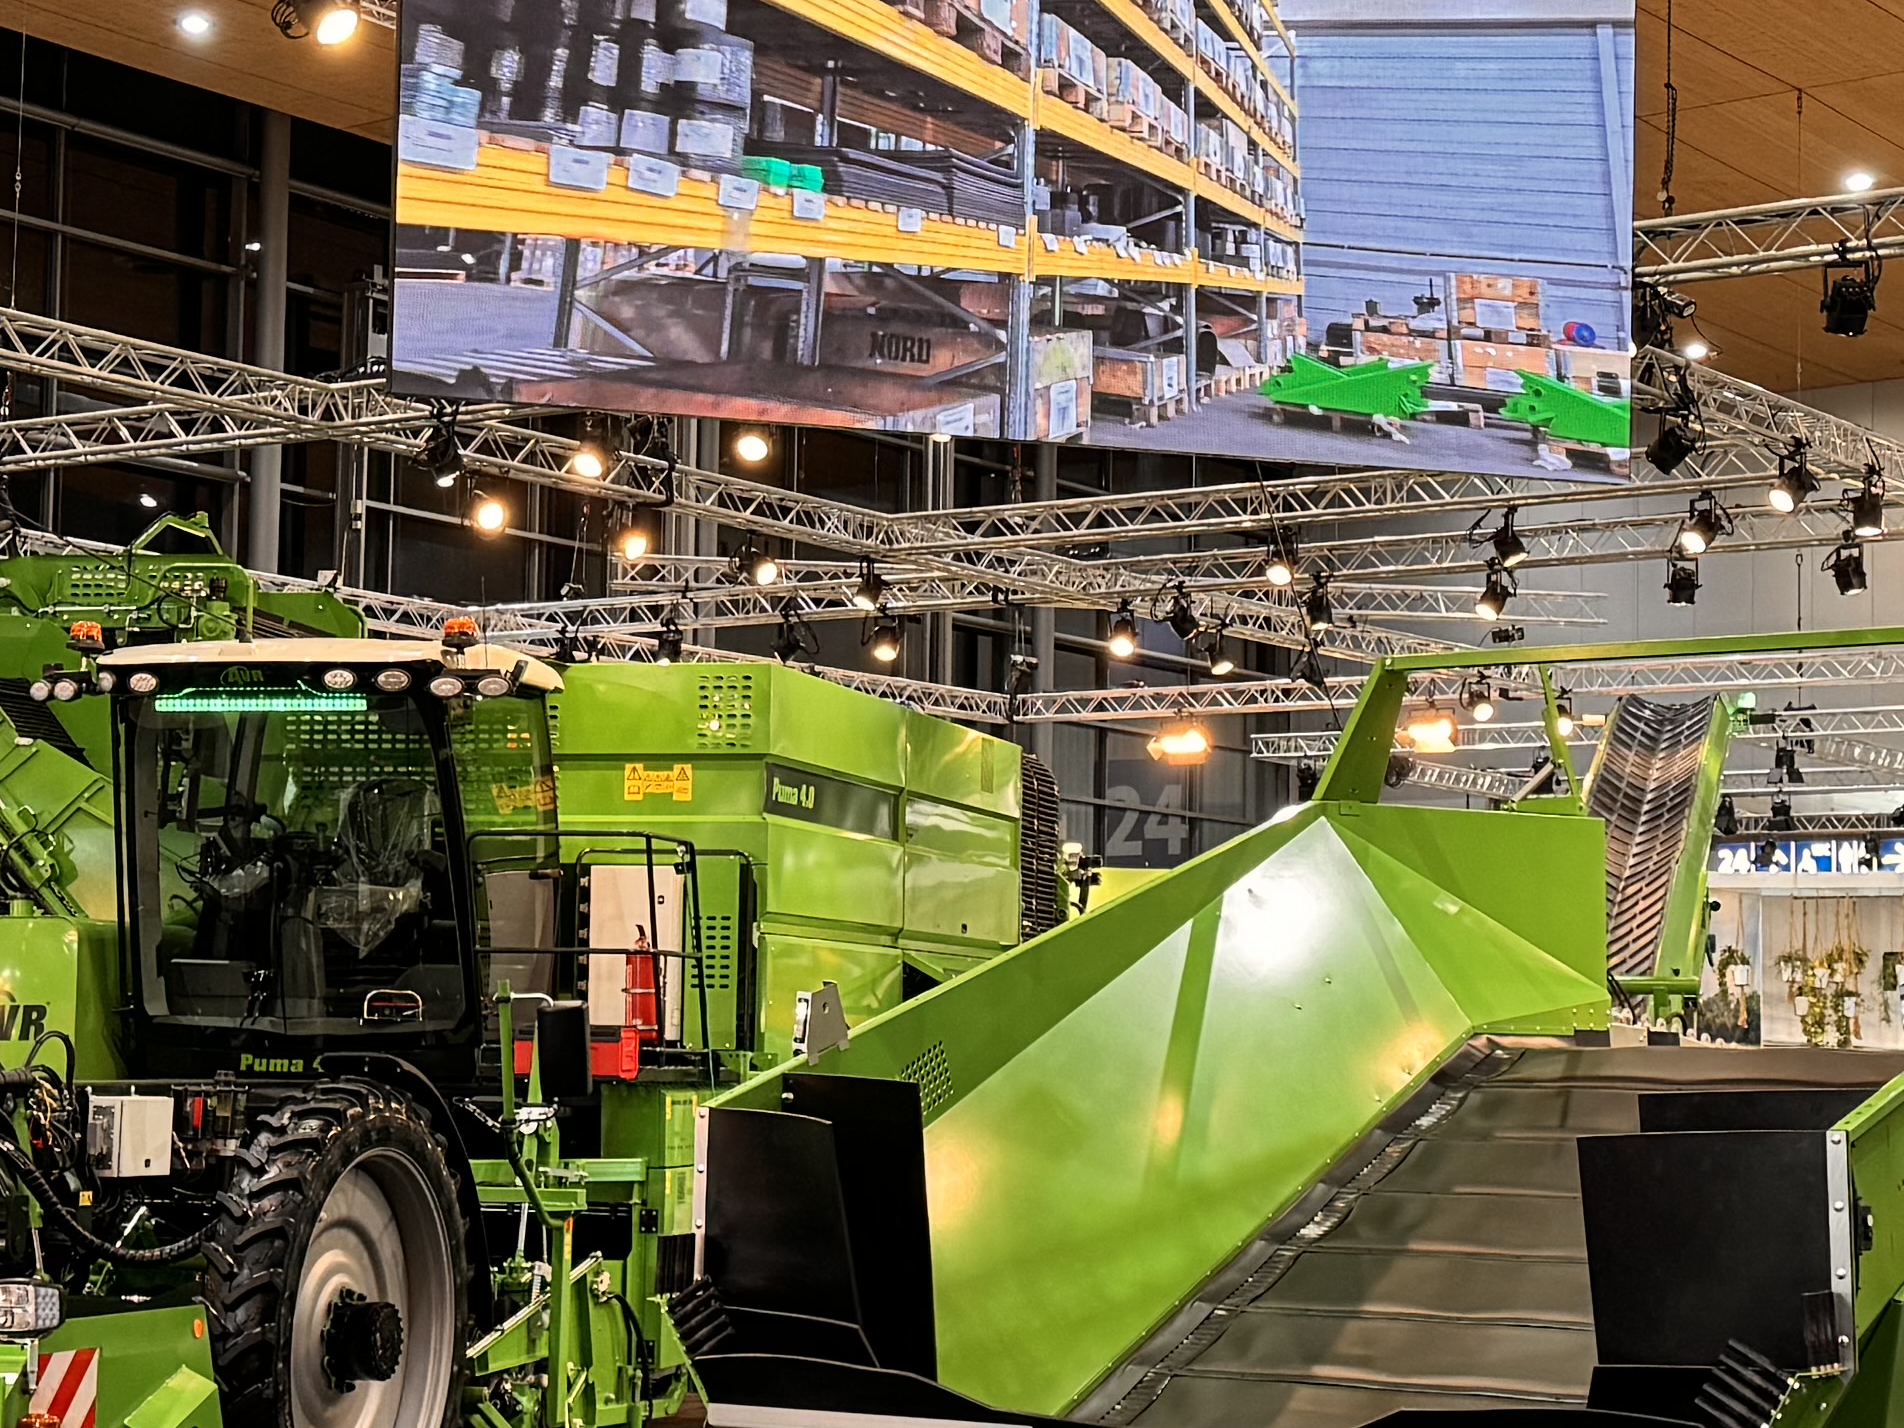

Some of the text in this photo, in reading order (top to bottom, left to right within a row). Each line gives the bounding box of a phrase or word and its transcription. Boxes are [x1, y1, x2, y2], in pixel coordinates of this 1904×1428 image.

[772, 776, 815, 809] Puma 4.0
[1105, 784, 1189, 857] 24
[240, 1053, 304, 1073] Puma
